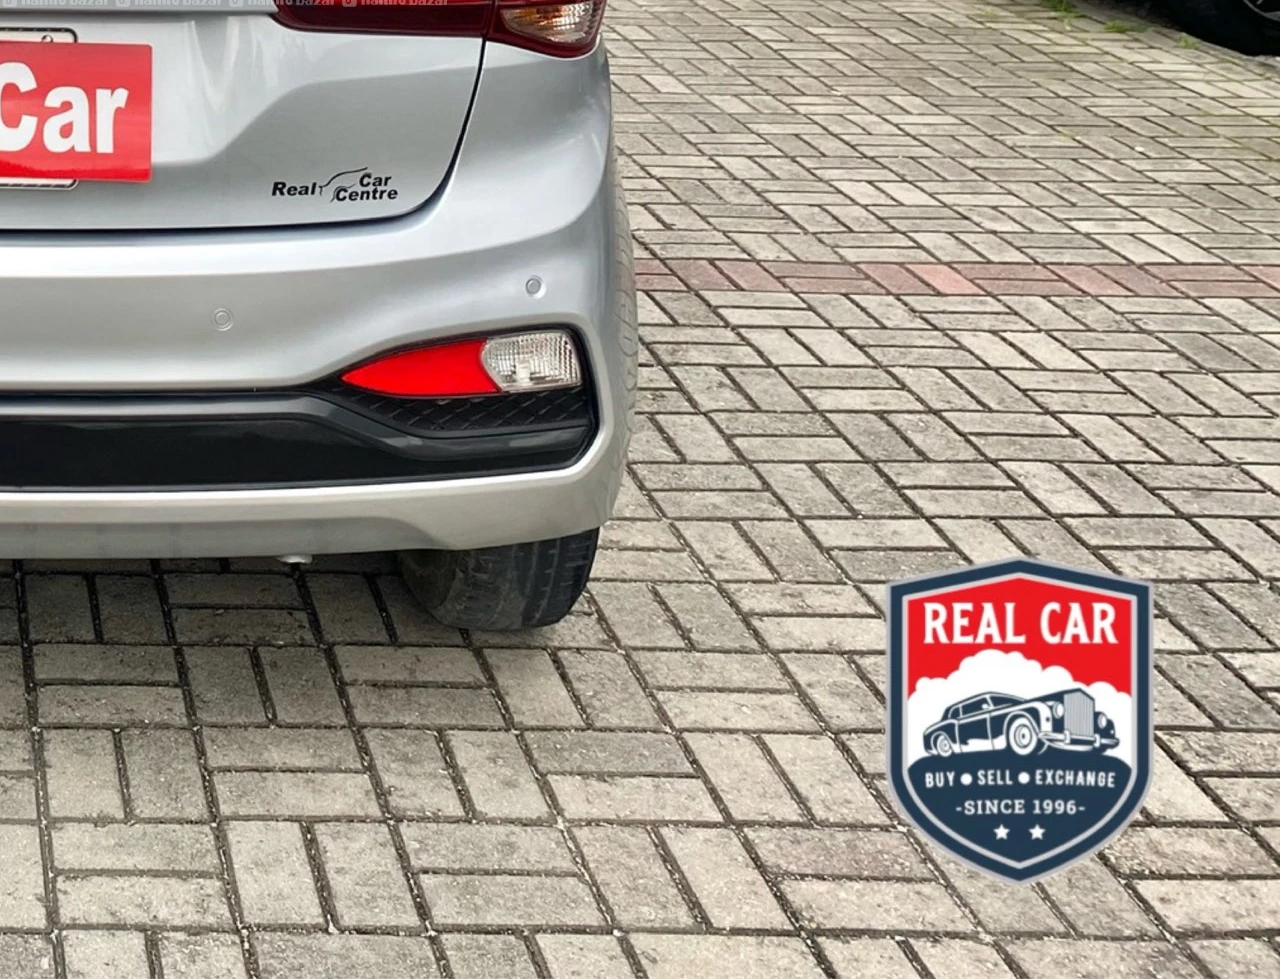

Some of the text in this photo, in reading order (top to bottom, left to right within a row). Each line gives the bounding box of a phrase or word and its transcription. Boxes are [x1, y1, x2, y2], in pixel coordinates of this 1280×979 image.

[271, 172, 392, 197] Real Car
[335, 187, 398, 202] Centre
